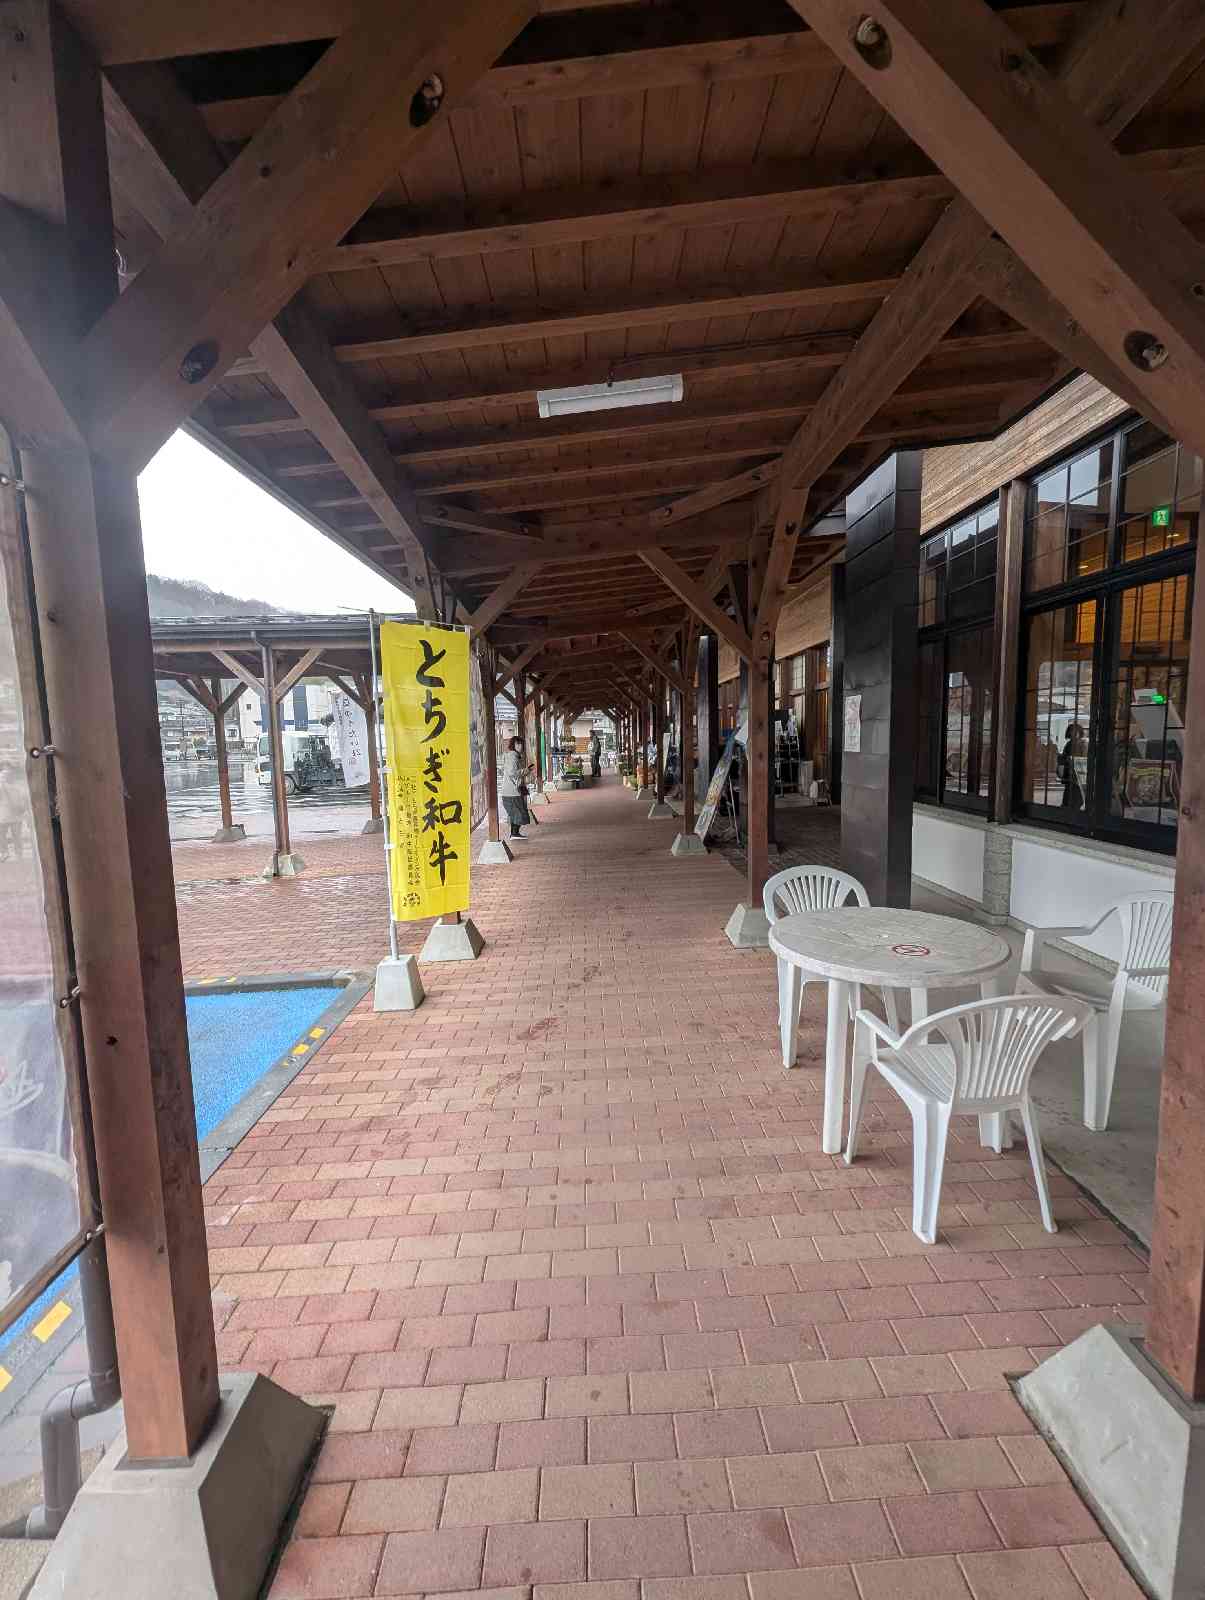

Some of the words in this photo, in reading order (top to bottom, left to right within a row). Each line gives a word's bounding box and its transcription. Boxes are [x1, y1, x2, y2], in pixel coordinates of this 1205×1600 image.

[415, 639, 463, 887] とちぎ和牛
